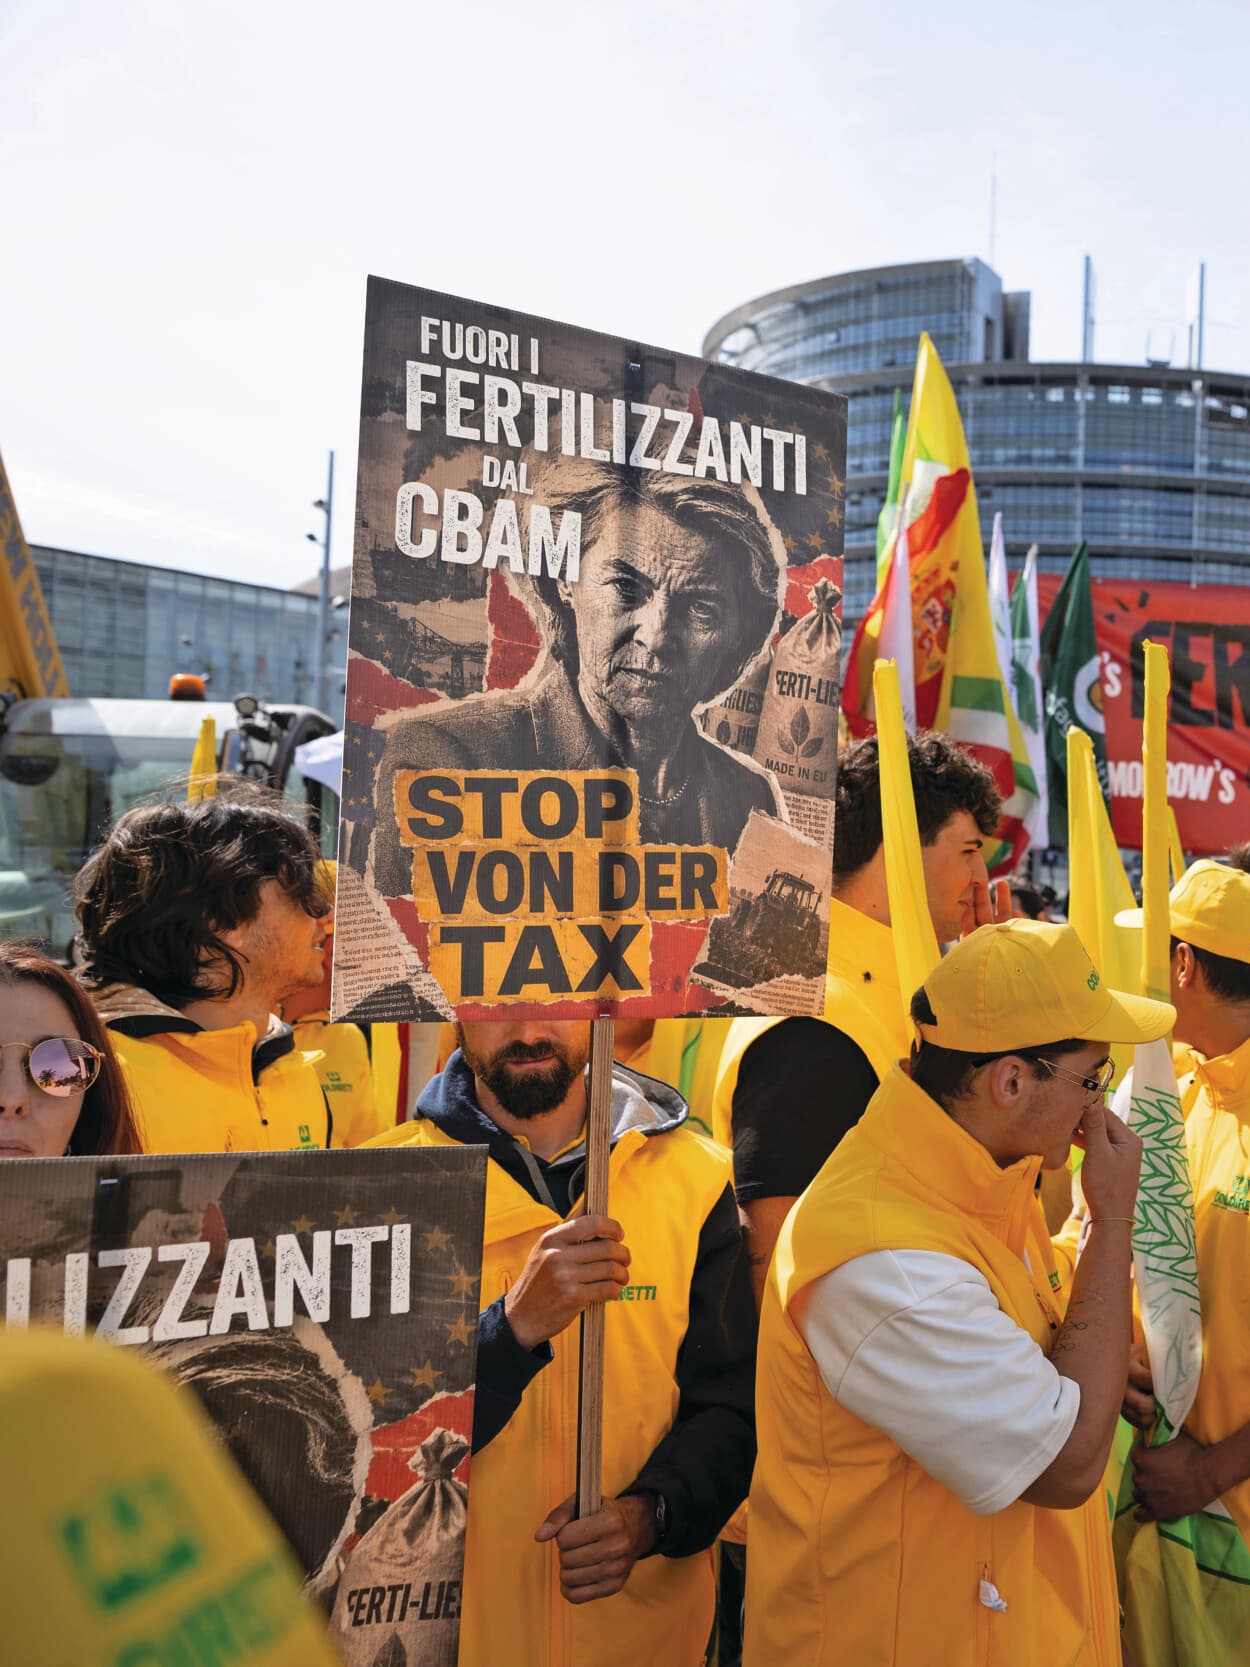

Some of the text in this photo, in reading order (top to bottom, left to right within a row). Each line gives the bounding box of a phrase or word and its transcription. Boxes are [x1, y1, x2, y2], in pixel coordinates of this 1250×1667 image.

[420, 316, 540, 375] FUORI I
[405, 359, 807, 496] FERTILIZZANTI
[482, 455, 534, 495] DAL
[394, 481, 582, 583] CBAM
[775, 670, 840, 709] FERTI-LIE
[765, 758, 828, 782] MADE IN EU
[407, 775, 634, 841] STOP
[428, 850, 719, 915] VON DER
[439, 922, 643, 998] TAX
